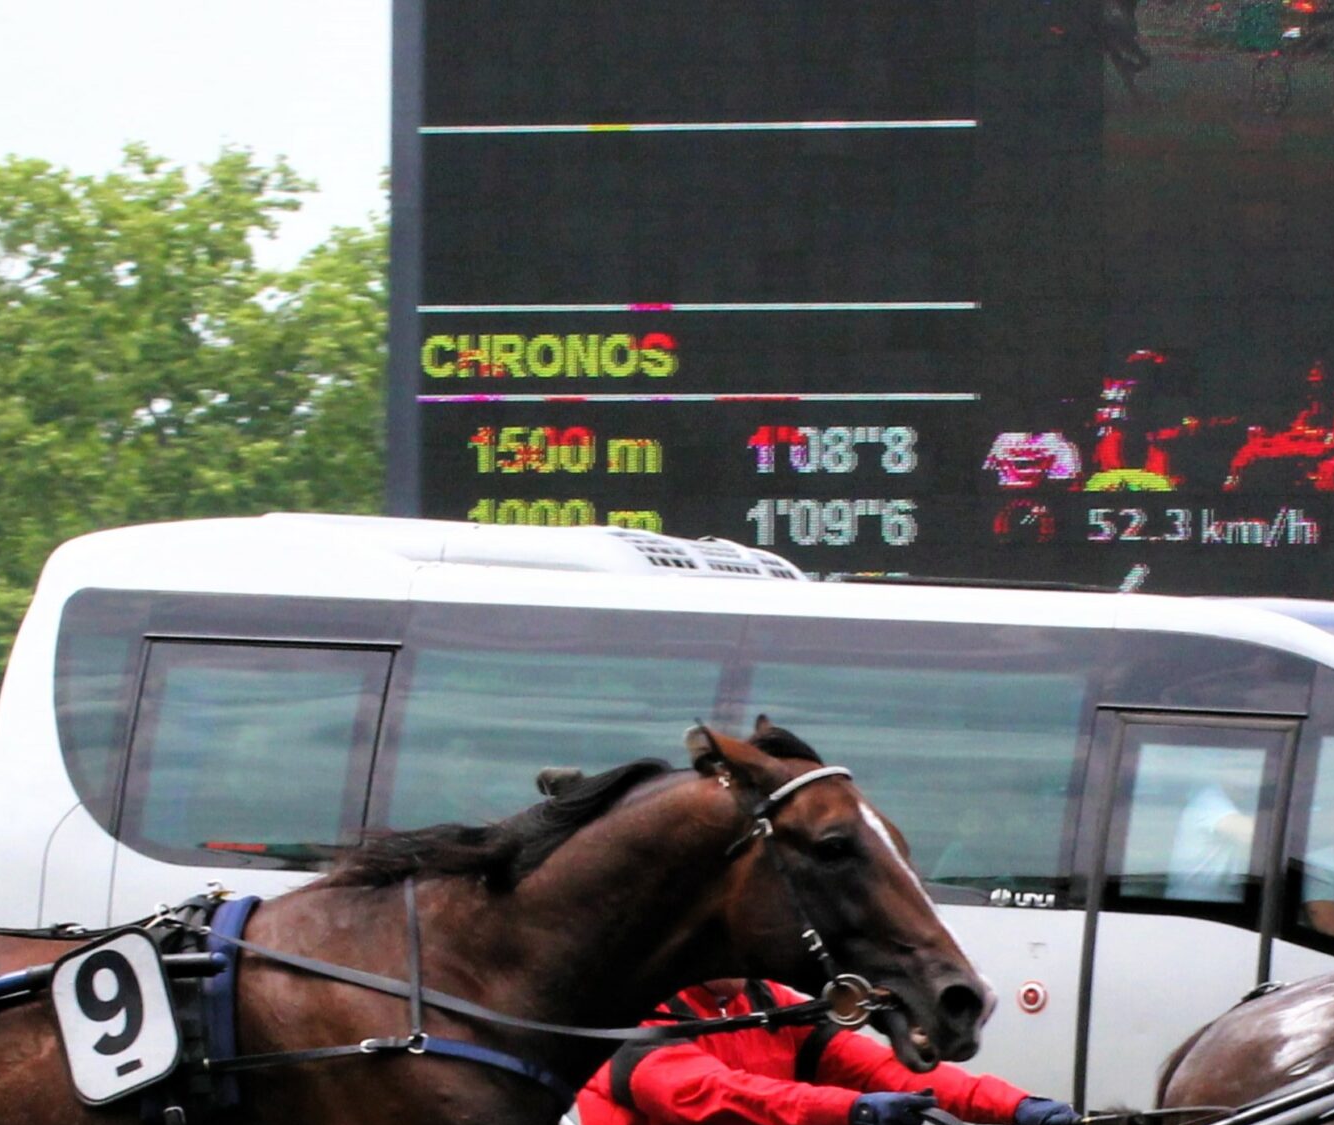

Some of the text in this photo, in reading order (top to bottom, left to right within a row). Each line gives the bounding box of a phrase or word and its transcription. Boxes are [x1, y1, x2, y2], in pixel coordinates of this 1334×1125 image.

[421, 333, 678, 378] CHRONOS
[469, 426, 662, 474] 1500 m
[1087, 507, 1320, 546] 52.3 km/h
[74, 949, 144, 1056] 9
